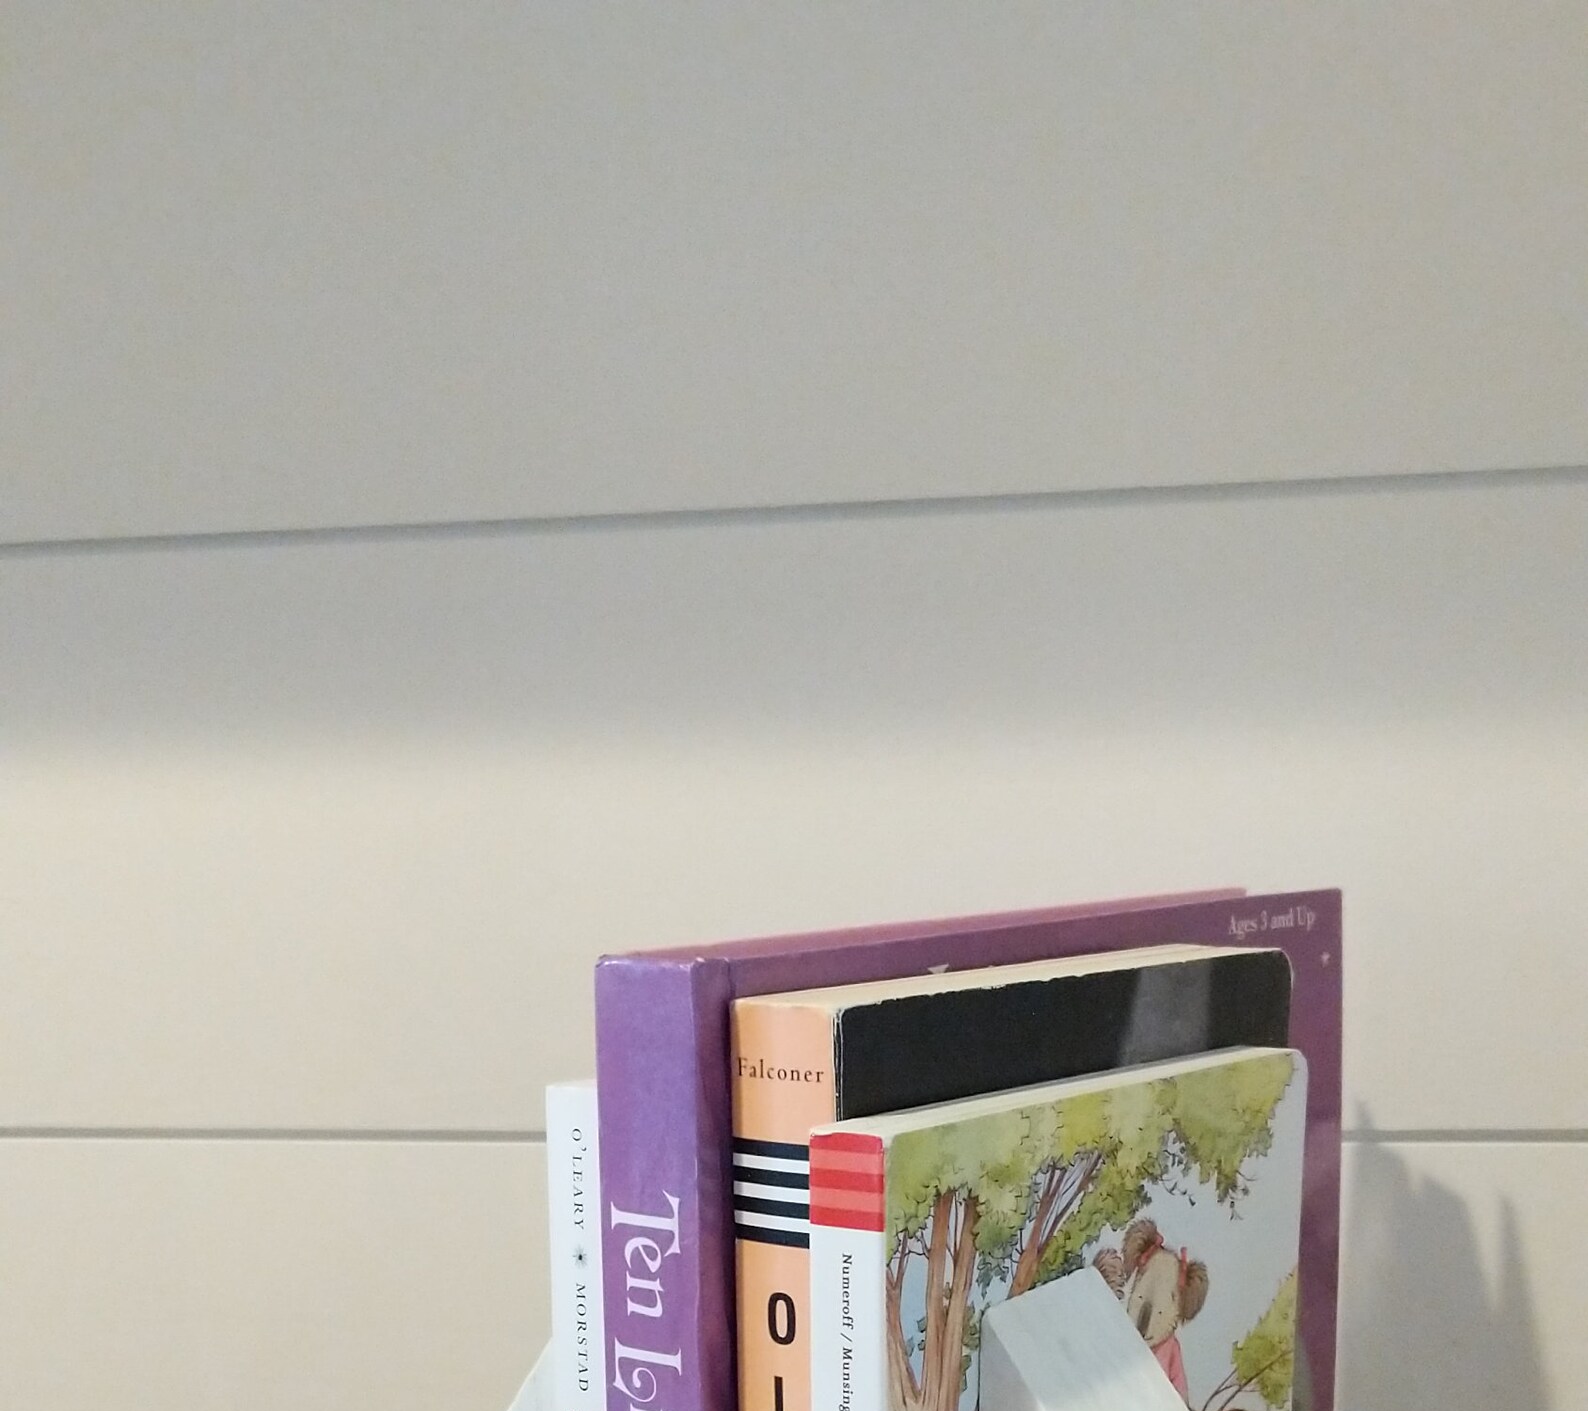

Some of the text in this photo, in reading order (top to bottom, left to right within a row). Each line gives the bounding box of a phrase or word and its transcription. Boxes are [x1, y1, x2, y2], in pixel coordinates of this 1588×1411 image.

[1228, 905, 1317, 940] Ages 3 and Up
[738, 1056, 825, 1084] Falconer
[571, 1127, 590, 1393] O'LEARY MORSTAD
[610, 1189, 682, 1319] Ten
[841, 1253, 855, 1330] Numeroff
